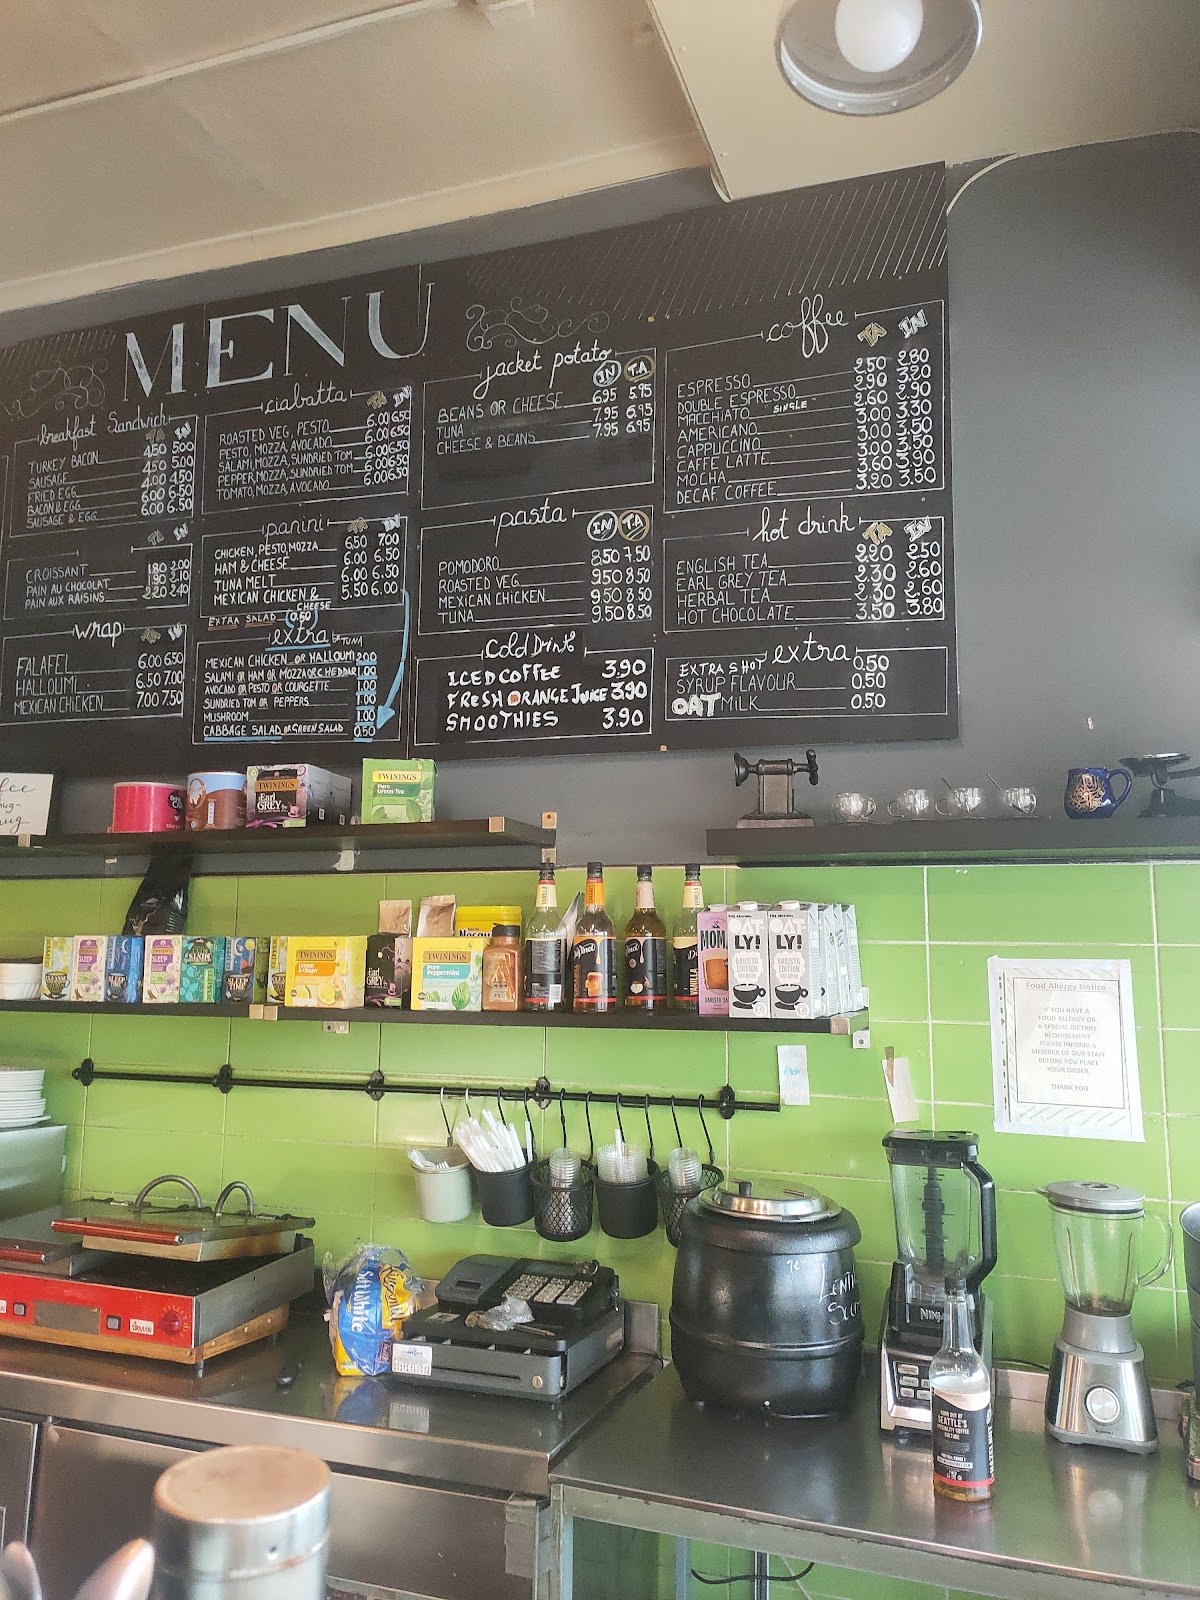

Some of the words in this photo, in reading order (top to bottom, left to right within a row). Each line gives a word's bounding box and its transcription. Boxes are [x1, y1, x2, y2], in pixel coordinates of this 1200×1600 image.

[766, 293, 849, 358] coffee
[858, 322, 887, 347] TA
[898, 309, 928, 339] IN
[122, 283, 435, 402] MENU
[473, 349, 542, 399] jacket
[549, 339, 613, 389] potato
[598, 365, 616, 382] IN
[677, 373, 750, 398] ESPRESSO
[853, 356, 886, 374] 2.50
[897, 348, 929, 365] 2.80
[265, 380, 347, 414] ciabatta
[678, 394, 722, 414] DOUBLE
[730, 384, 795, 407] ESPRESSO
[854, 372, 887, 391] 2.90
[897, 364, 931, 383] 3.20
[438, 404, 483, 423] BEANS
[490, 400, 506, 416] OR
[513, 392, 563, 414] CHEESE
[629, 383, 652, 399] 5.95
[773, 401, 807, 413] SINGLE
[40, 414, 97, 450] breakfast
[107, 402, 168, 433] Sandwich
[219, 428, 265, 445] ROASTED
[297, 419, 329, 435] PESTO
[367, 412, 388, 427] 6.00
[436, 424, 463, 439] TUNA
[593, 406, 619, 422] 7.95
[626, 403, 653, 419] 6.95
[436, 437, 481, 455] CHEESE
[485, 438, 493, 449] &
[498, 432, 535, 448] BEANS
[593, 421, 619, 438] 7.95
[28, 457, 66, 474] TURKEY
[71, 450, 98, 468] BACON
[677, 457, 722, 473] CAFFE
[726, 452, 771, 468] LATTE
[856, 440, 892, 459] 3.00
[898, 435, 933, 451] 3.50
[28, 472, 69, 489] SAUSAGE
[677, 470, 726, 487] MOCHA
[857, 455, 892, 473] 3.60
[896, 450, 935, 469] 3.90
[725, 481, 777, 500] COFFEE
[856, 472, 892, 490] 3.20
[899, 467, 936, 487] 3.50
[27, 515, 64, 529] SAUSAGE
[78, 511, 97, 522] EGG
[265, 514, 324, 545] panini
[495, 497, 567, 548] pasta
[752, 506, 790, 543] hot
[798, 502, 855, 535] drink
[214, 562, 236, 576] HAM
[240, 561, 249, 572] &
[251, 557, 290, 570] CHEESE
[344, 551, 367, 565] 6.00
[374, 549, 400, 562] 6.50
[438, 556, 499, 576] POMODORO
[591, 549, 619, 566] 8.50
[624, 545, 650, 562] 7.50
[214, 579, 242, 592] TUNA
[246, 574, 277, 588] MELT
[341, 568, 367, 582] 6.00
[372, 565, 399, 579] 6.50
[438, 576, 490, 594] ROASTED
[496, 574, 520, 589] VEG
[677, 575, 714, 591] EARL
[718, 572, 753, 588] GREY
[759, 569, 787, 586] TEA
[855, 563, 896, 583] 2.30
[906, 560, 941, 580] 2.60
[264, 588, 305, 602] CHICKEN
[297, 601, 331, 610] CHEESE
[677, 590, 735, 607] HERBAL
[740, 588, 770, 603] TEA
[854, 583, 895, 603] 2.30
[904, 579, 942, 598] 2.60
[209, 616, 239, 626] EXTRA
[246, 613, 276, 623] SALAD
[438, 610, 474, 624] TUNA
[591, 605, 624, 623] 9.50
[627, 604, 652, 620] 8.50
[677, 608, 707, 625] HOT
[712, 605, 795, 624] CHOCOLATE
[856, 602, 895, 621] 3.50
[906, 597, 943, 616] 3.80
[74, 621, 122, 648] wrap
[272, 619, 329, 645] extra
[485, 632, 529, 658] Cold
[772, 632, 851, 664] extra
[17, 654, 74, 677] FALAFEL
[138, 654, 162, 669] 6.00
[448, 670, 495, 687] ICED
[499, 664, 561, 684] COFFEE
[602, 659, 646, 679] 3.90
[679, 660, 725, 677] EXTRA
[729, 656, 767, 674] SHOT
[853, 654, 889, 672] 0.50
[15, 676, 77, 696] HALLOUMI
[136, 673, 161, 689] 6.50
[508, 688, 568, 707] ORANGE
[611, 681, 647, 699] 3.90
[677, 675, 726, 694] SYRUP
[731, 672, 796, 692] FLAVOUR
[851, 672, 886, 690] 0.50
[204, 711, 249, 722] MUSHROOM
[357, 710, 375, 721] 1.00
[672, 692, 721, 717] OAT
[851, 693, 886, 709] 0.50
[203, 725, 246, 737] CABBAGE
[251, 724, 281, 735] SALAD
[446, 710, 559, 731] SMOOTHIES
[602, 707, 644, 729] 3.90
[378, 773, 417, 781] TWININGS
[257, 800, 282, 810] GREY
[735, 935, 760, 949] LY!
[776, 935, 802, 949] LY!
[367, 968, 380, 976] Earl
[367, 976, 383, 986] GREY
[690, 968, 698, 996] VANILLA
[1048, 982, 1077, 991] Allergy
[938, 1415, 967, 1428] SEATTLE'S
